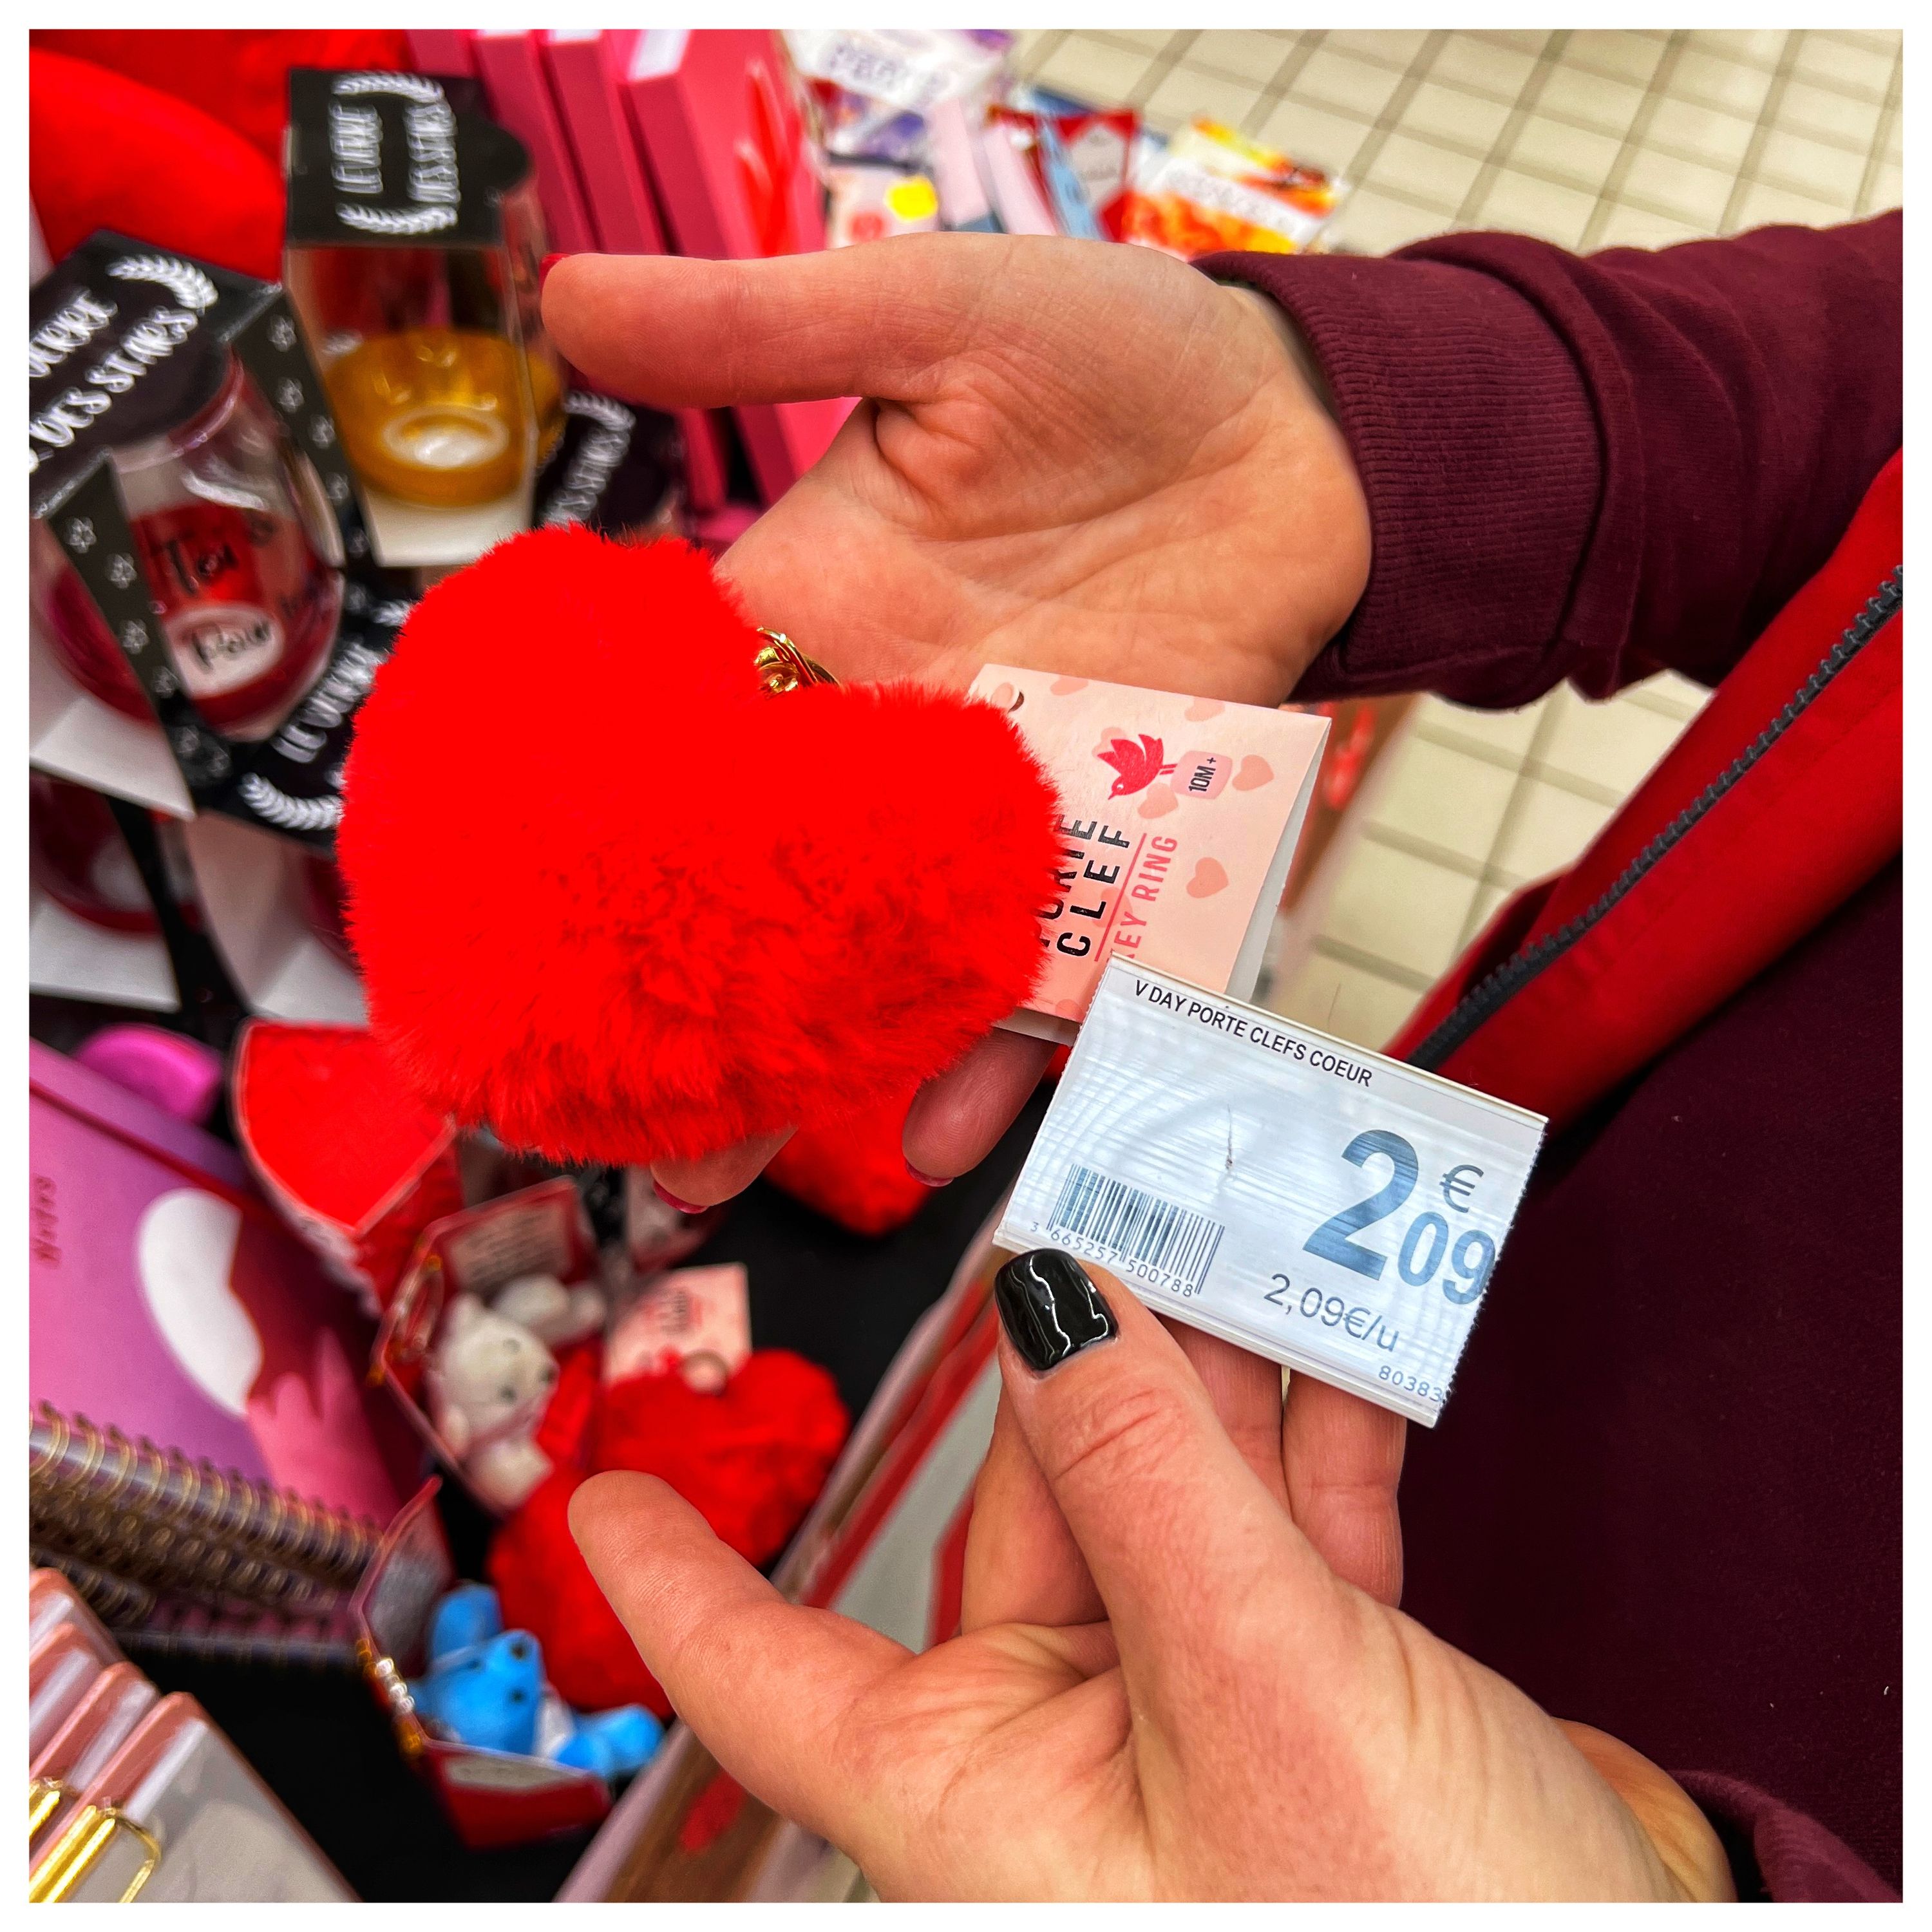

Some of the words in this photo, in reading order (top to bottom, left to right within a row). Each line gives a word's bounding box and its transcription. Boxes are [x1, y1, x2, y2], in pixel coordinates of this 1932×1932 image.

[1057, 825, 1130, 956] CLEF
[1107, 911, 1147, 962] EY
[1132, 836, 1178, 902] RING
[1136, 980, 1148, 996] V
[1148, 986, 1187, 1012] DAY
[1188, 1001, 1247, 1037] PORTE
[1250, 1027, 1307, 1060] CLEFS
[1309, 1050, 1372, 1087] COEUR
[1302, 1129, 1419, 1281] 2
[1439, 1164, 1484, 1213] €
[1050, 1228, 1119, 1265] 665257
[1126, 1258, 1193, 1298] 500788
[1397, 1211, 1495, 1305] 09
[1264, 1273, 1400, 1352] 2,09€/u
